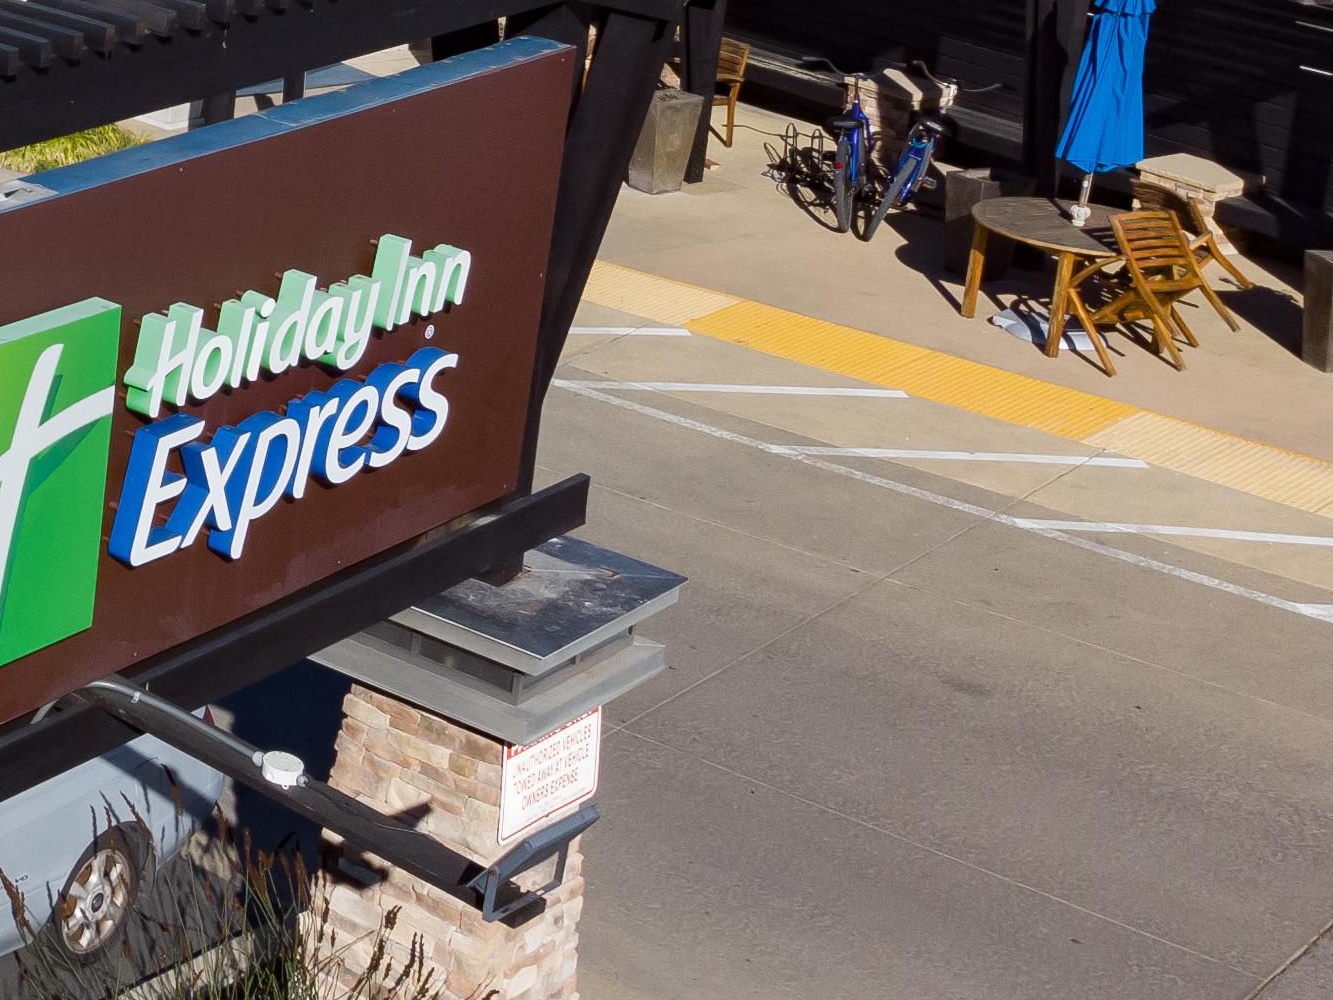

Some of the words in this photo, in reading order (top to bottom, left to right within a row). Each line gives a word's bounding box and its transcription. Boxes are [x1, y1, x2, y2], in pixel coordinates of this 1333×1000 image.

[136, 271, 381, 418] Holiday
[381, 237, 471, 331] Inn
[125, 350, 459, 567] Express
[562, 723, 592, 751] VEHICLES
[513, 772, 536, 795] TOWED
[536, 763, 553, 782] AWAY
[564, 742, 590, 768] VEHICLE
[549, 766, 579, 795] EXPENSE
